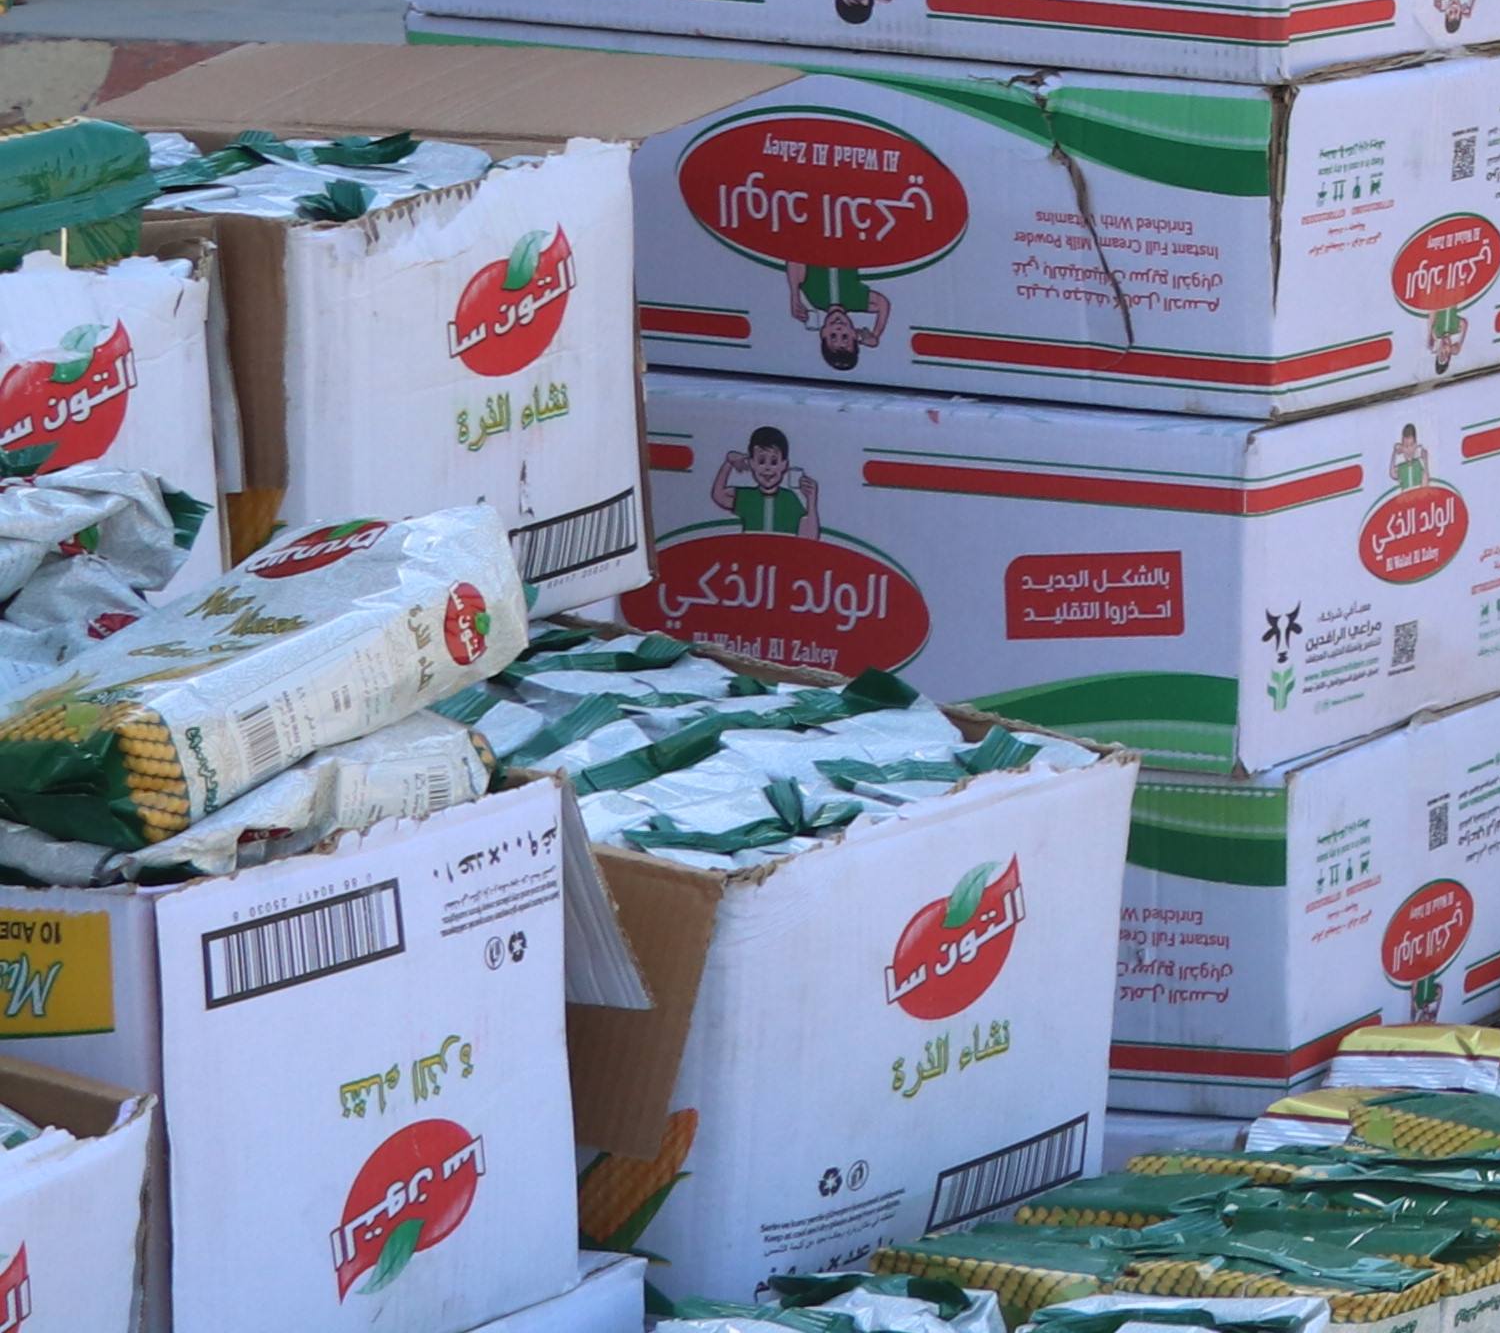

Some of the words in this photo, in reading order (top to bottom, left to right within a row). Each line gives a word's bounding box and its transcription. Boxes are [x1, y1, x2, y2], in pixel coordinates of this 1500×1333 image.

[719, 171, 808, 232] الولد
[823, 174, 933, 241] الذكي
[494, 253, 577, 336] التون
[1406, 260, 1444, 299] الولد
[1447, 239, 1492, 290] الذكي
[447, 320, 488, 359] سا
[456, 391, 511, 452] الذرة
[520, 381, 569, 430] نشاء
[1373, 508, 1416, 560] الذكي
[1420, 497, 1454, 537] الولد
[657, 561, 775, 628] الذكي
[791, 569, 889, 630] الولد
[768, 640, 785, 661] Al
[791, 641, 839, 668] Zakey
[935, 884, 1027, 977] التون
[885, 965, 927, 1006] سا
[330, 1165, 435, 1272] التون
[441, 1134, 487, 1178] سا
